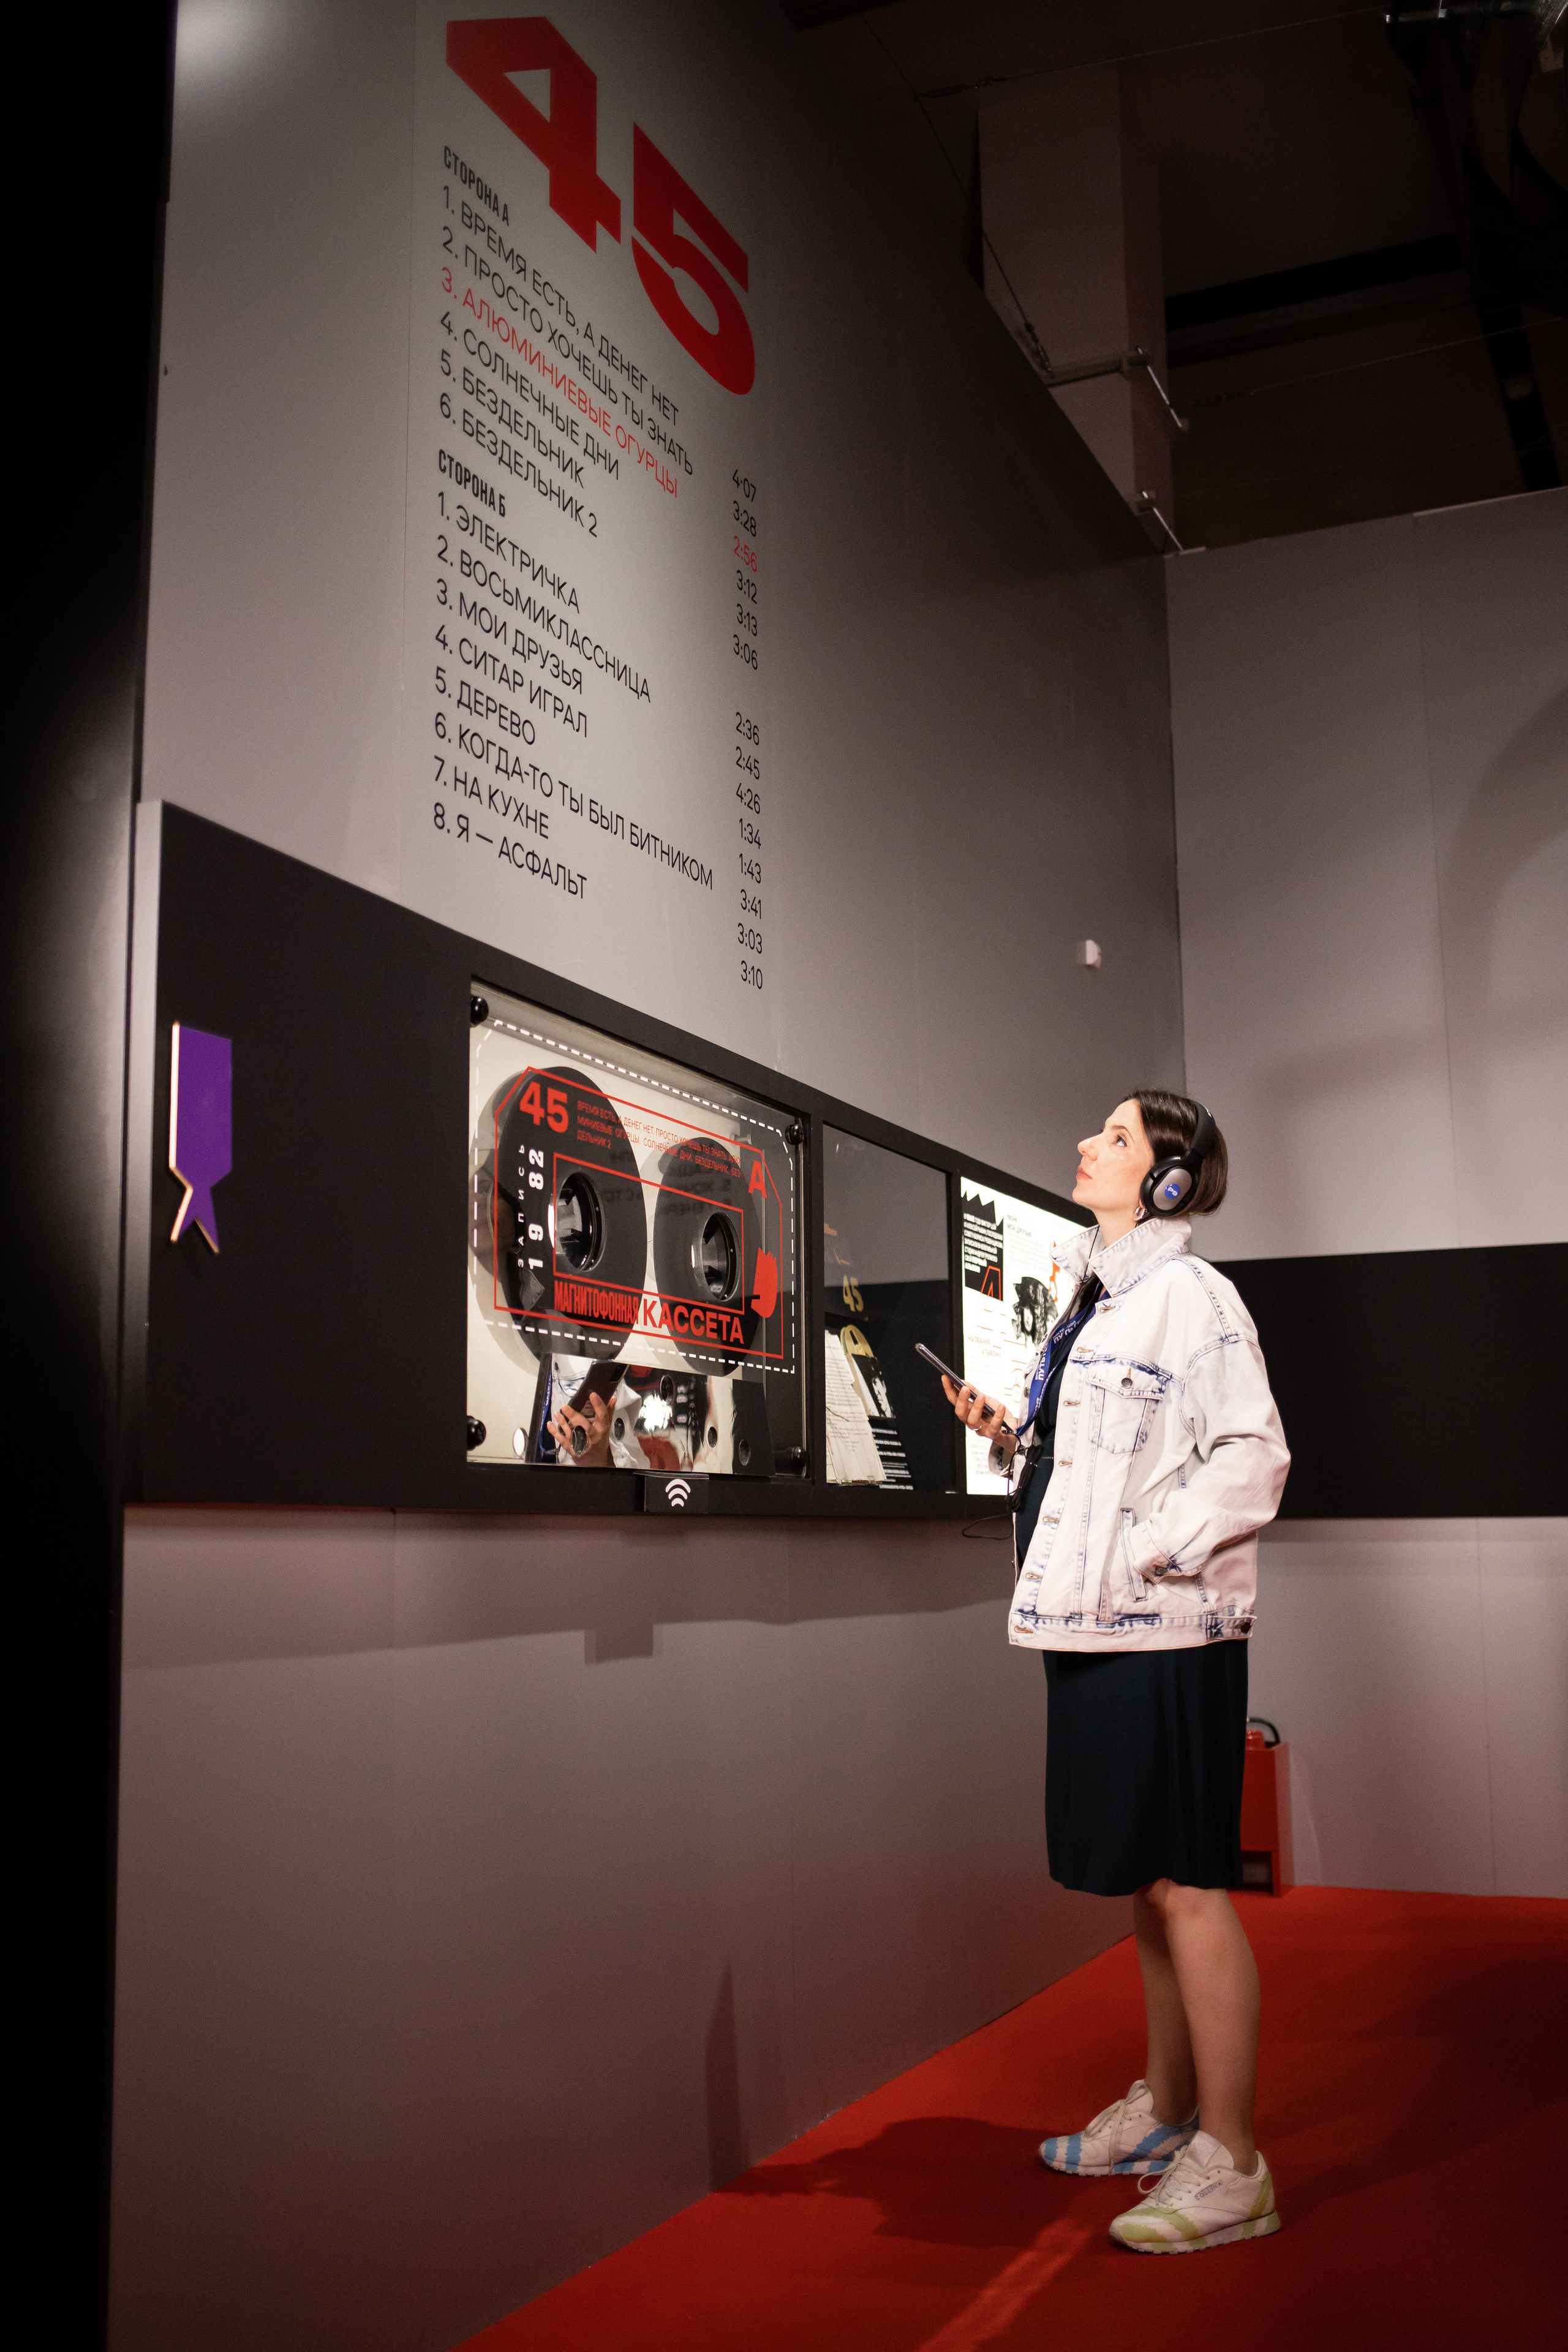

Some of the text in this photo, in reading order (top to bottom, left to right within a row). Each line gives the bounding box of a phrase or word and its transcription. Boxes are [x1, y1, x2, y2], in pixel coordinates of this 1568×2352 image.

[443, 145, 510, 227] СТОРОНА А
[447, 17, 755, 395] 45
[442, 225, 757, 538] 2. ПРОСТО ХОЧЕШЬ ТЫ ЗНАТЬ 3:28
[443, 185, 454, 214] 1.
[461, 200, 527, 282] ВРЕМЯ
[583, 322, 595, 348] А
[598, 334, 648, 394] ДЕНЕГ
[651, 385, 679, 426] НЕТ
[438, 448, 506, 518] СТОРОНА Б
[440, 311, 758, 605] 4. СОЛНЕЧНЫЕ ДНИ 3:12
[440, 349, 758, 637] 5. БЕЗДЕЛЬНИК 3:13
[442, 266, 758, 573] 3. АЛЮМИНИЕВЫЕ ОГУРЦЫ 2:56
[438, 491, 760, 746] 1. ЭЛЕКТРИЧКА 2:36
[439, 392, 758, 671] 6. БЕЗДЕЛЬНИК 2 3:06
[435, 624, 762, 850] 4. СИТАР ИГРАЛ 1:34
[436, 578, 761, 815] 3. МОИ ДРУЗЬЯ 4:26
[437, 534, 760, 780] 2. ВОСЬМИКЛАССНИЦА 2:45
[434, 711, 762, 919] 6. КОГДА-ТО ТЫ БЫЛ БИТНИКОМ 3:41
[434, 755, 763, 954] 7. НА КУХНЕ 3:03
[435, 665, 762, 884] 5. ДЕРЕВО 1:43
[433, 802, 451, 834] 8.
[456, 813, 470, 843] Я
[498, 836, 587, 899] АСФАЛЬТ
[741, 960, 763, 990] 3:10
[519, 1082, 568, 1133] 45
[577, 1100, 599, 1116] ВРЕМЯ
[624, 1117, 642, 1130] ДЕНЕГ
[655, 1128, 678, 1143] ПРОСТО
[679, 1136, 701, 1152] ХОЧЕШЬ
[703, 1145, 710, 1155] ТЫ
[577, 1115, 613, 1136] МИНИЕВЫЕ
[643, 1137, 678, 1156] СОЛНЕЧНЫЕ
[577, 1129, 611, 1149] ДЕЛЬНИК 2
[748, 1161, 767, 1199] А
[554, 1280, 744, 1344] МАГНИТОФОННАЯ КАССЕТА
[843, 1275, 864, 1312] 45
